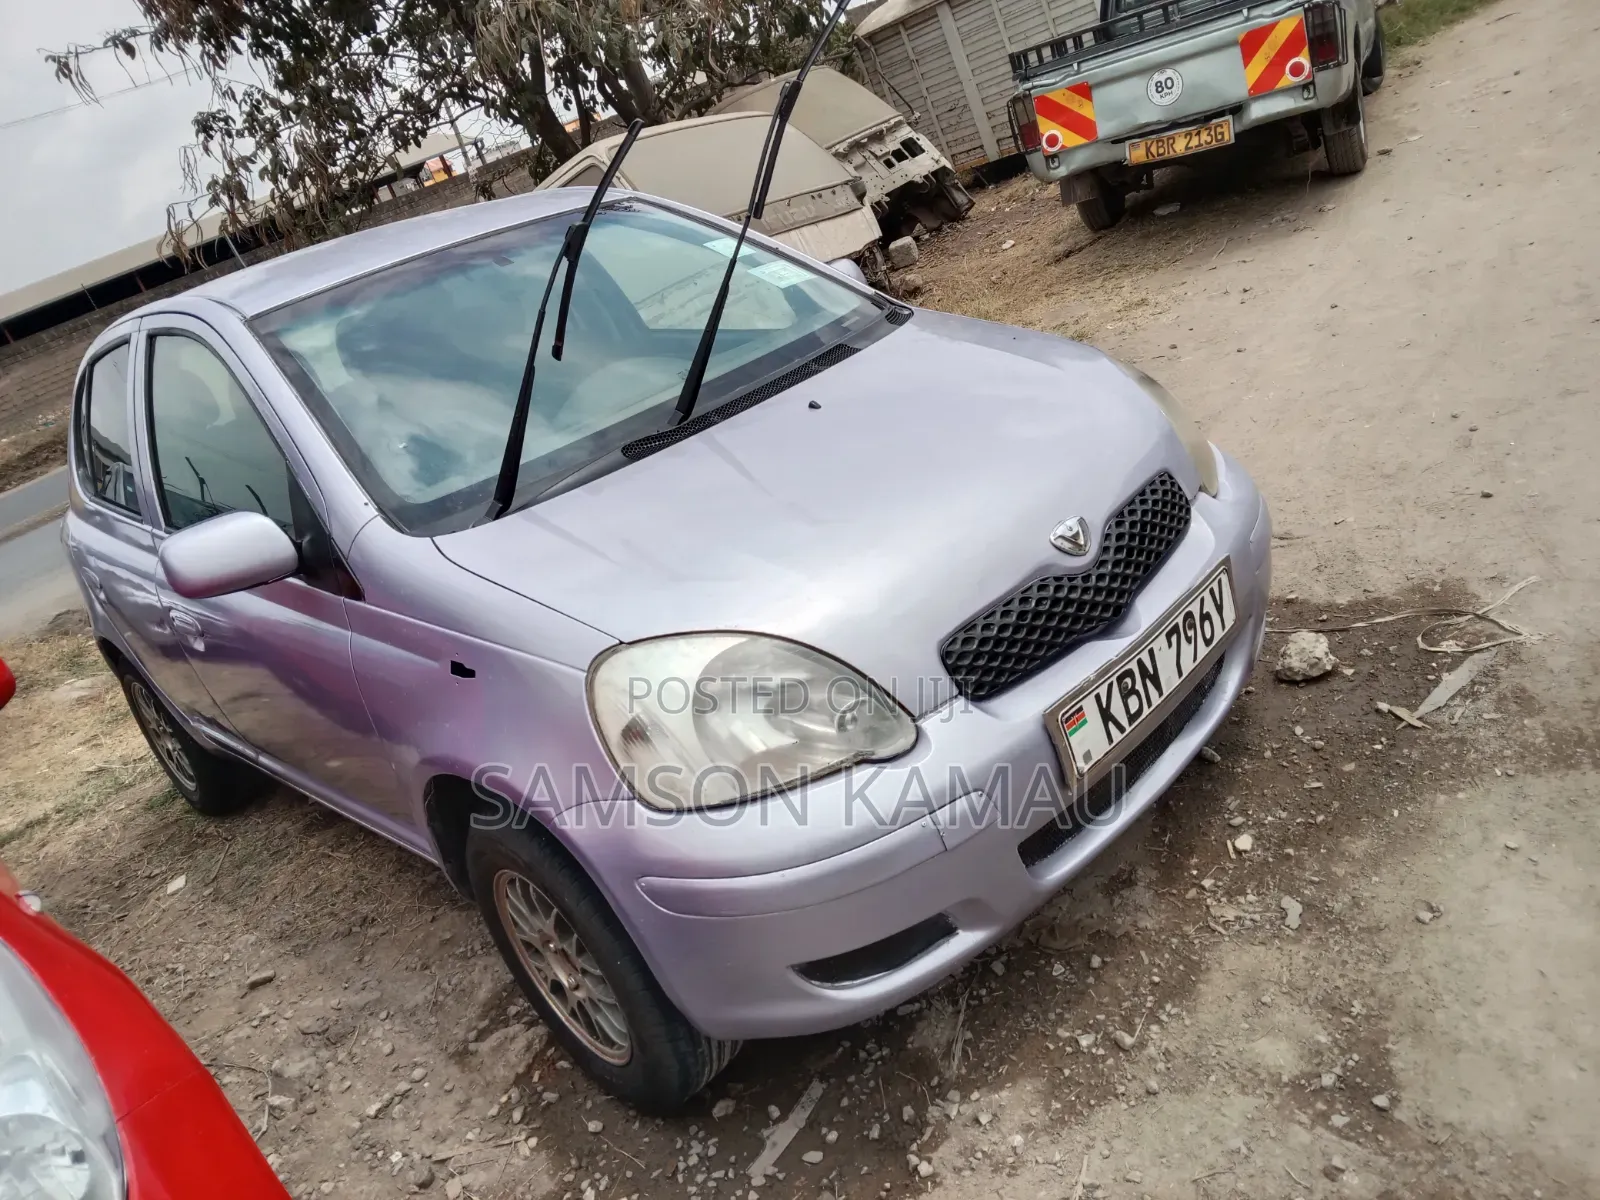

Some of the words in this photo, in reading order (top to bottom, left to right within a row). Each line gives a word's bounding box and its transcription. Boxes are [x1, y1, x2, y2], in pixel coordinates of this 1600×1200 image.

[1155, 76, 1174, 94] 80
[1159, 90, 1173, 99] KPH
[1144, 136, 1177, 160] KBR
[1184, 123, 1226, 151] 213G
[1094, 646, 1164, 746] KBN
[1165, 577, 1227, 679] 796Y
